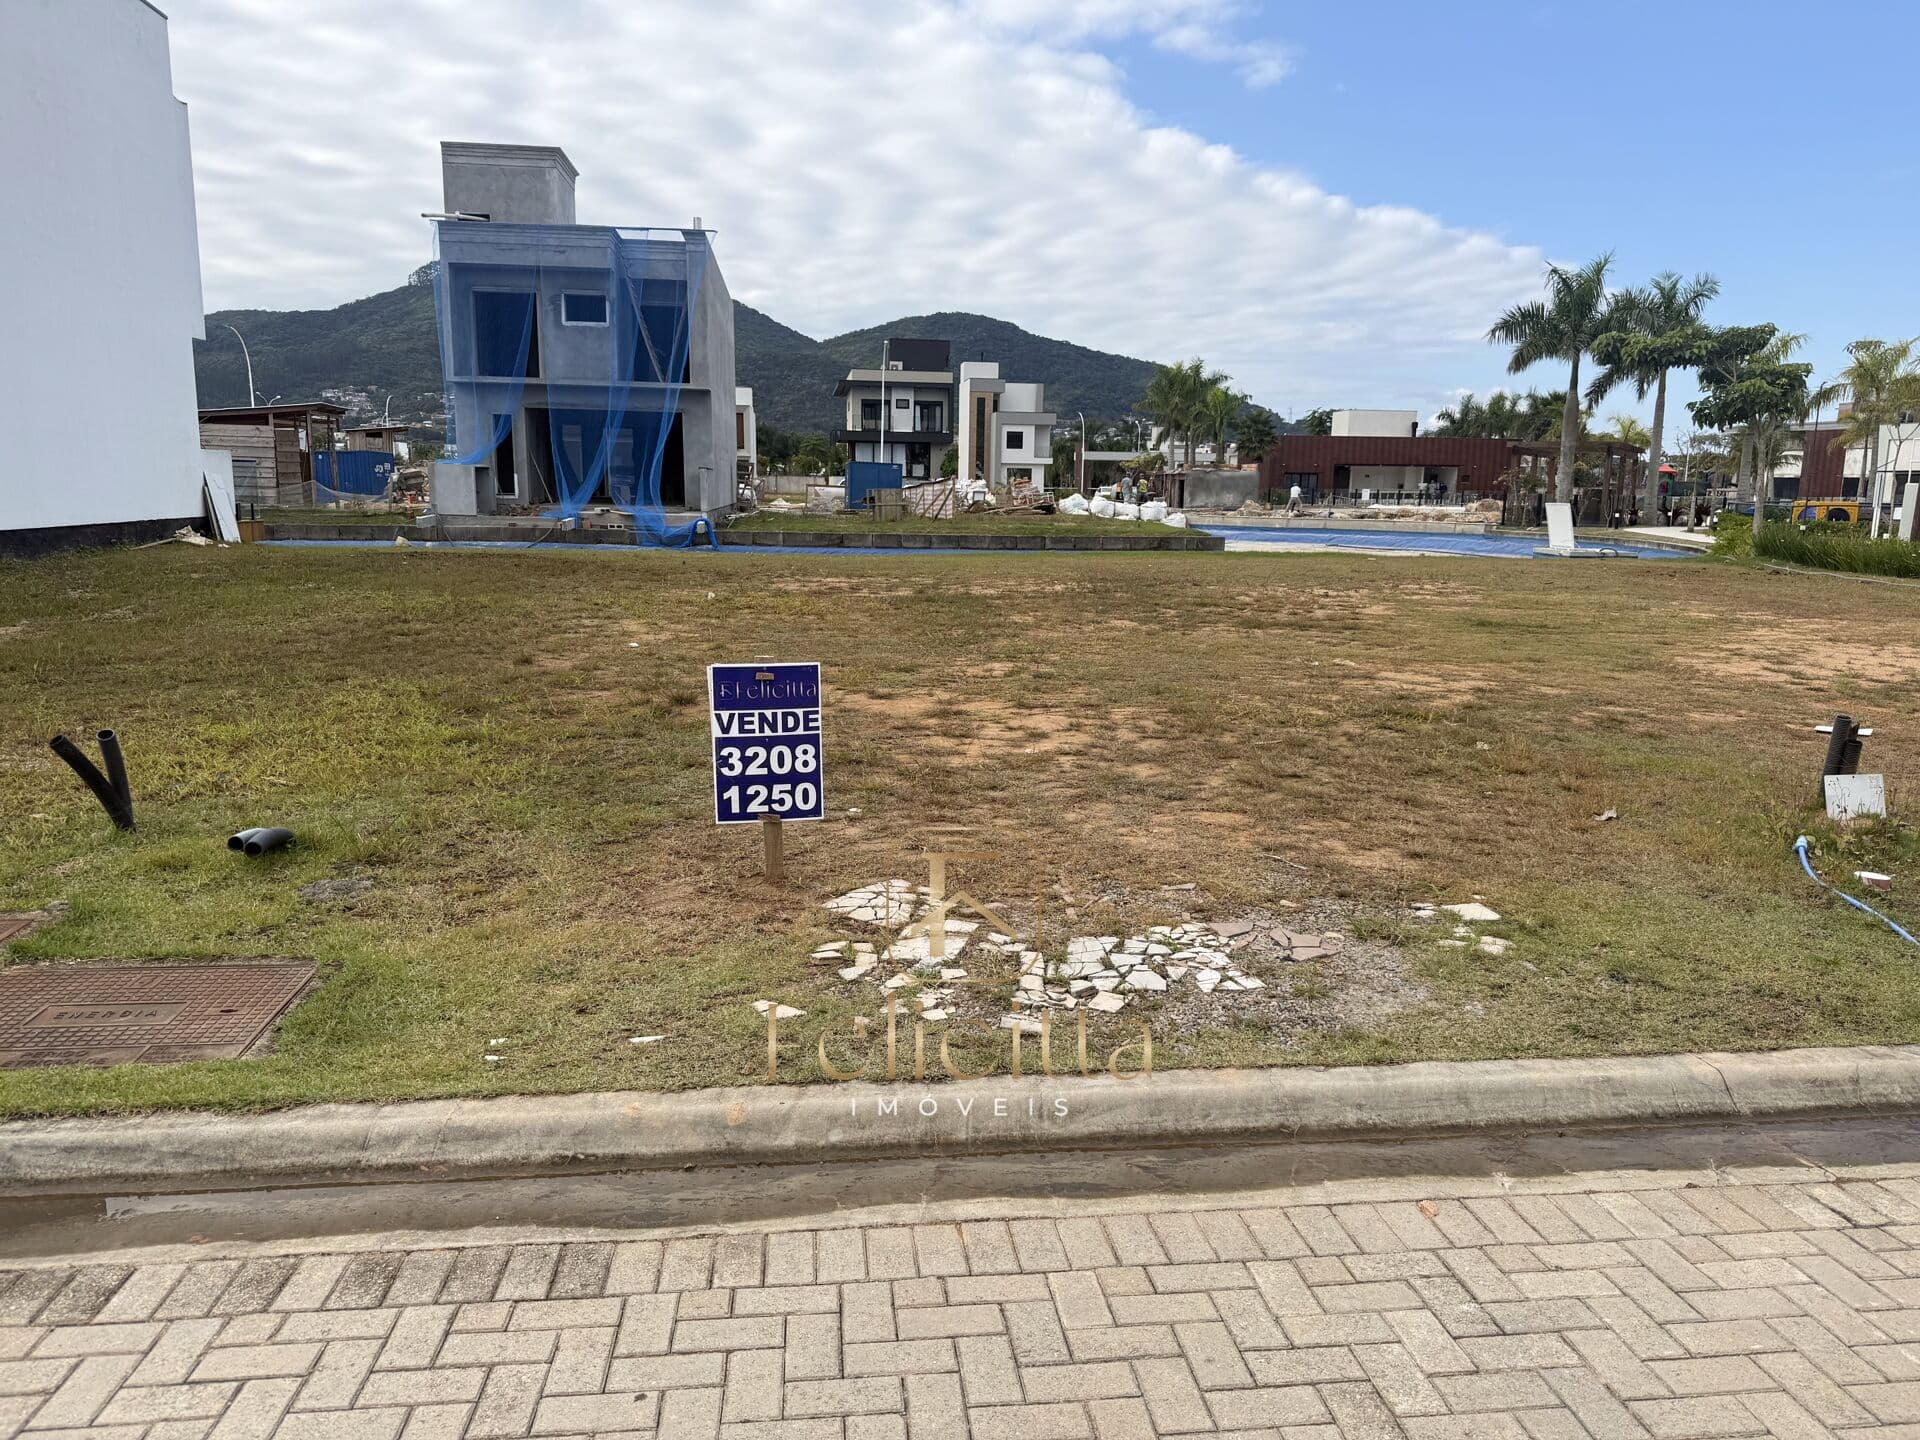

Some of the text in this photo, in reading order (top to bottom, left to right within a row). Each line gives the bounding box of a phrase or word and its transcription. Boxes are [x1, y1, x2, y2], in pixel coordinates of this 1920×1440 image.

[714, 709, 820, 735] VENDE
[719, 744, 817, 777] 3208
[722, 782, 817, 814] 1250
